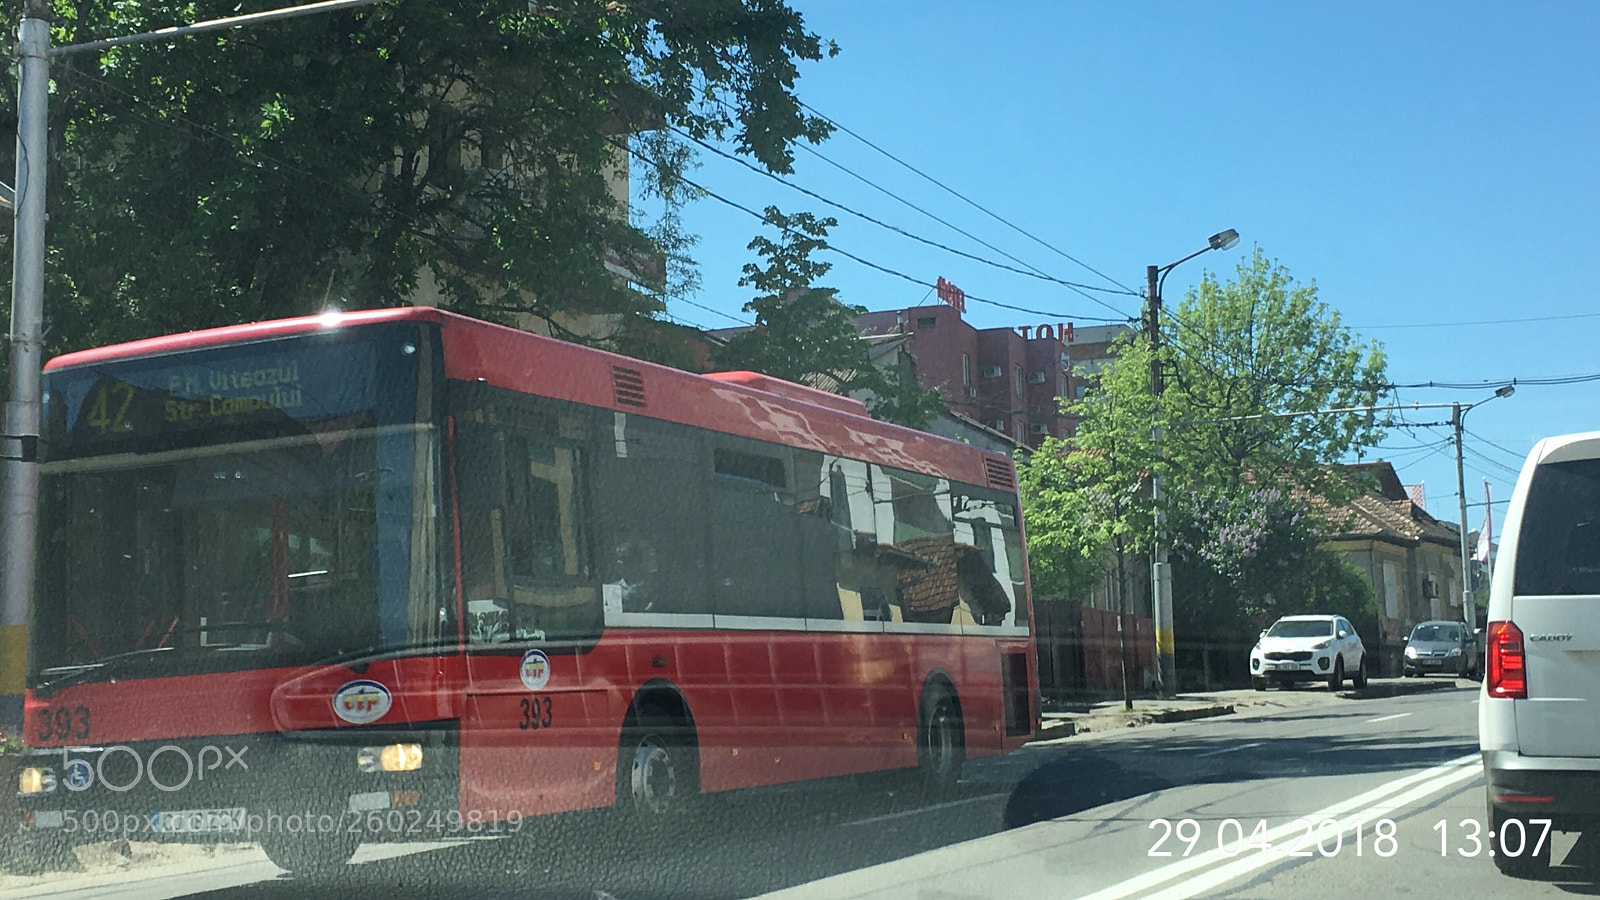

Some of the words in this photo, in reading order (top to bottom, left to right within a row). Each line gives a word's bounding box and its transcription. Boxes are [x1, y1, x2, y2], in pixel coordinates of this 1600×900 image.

[87, 382, 135, 433] 42
[1529, 634, 1575, 642] CADDY
[38, 705, 91, 741] 393
[519, 696, 553, 730] 393
